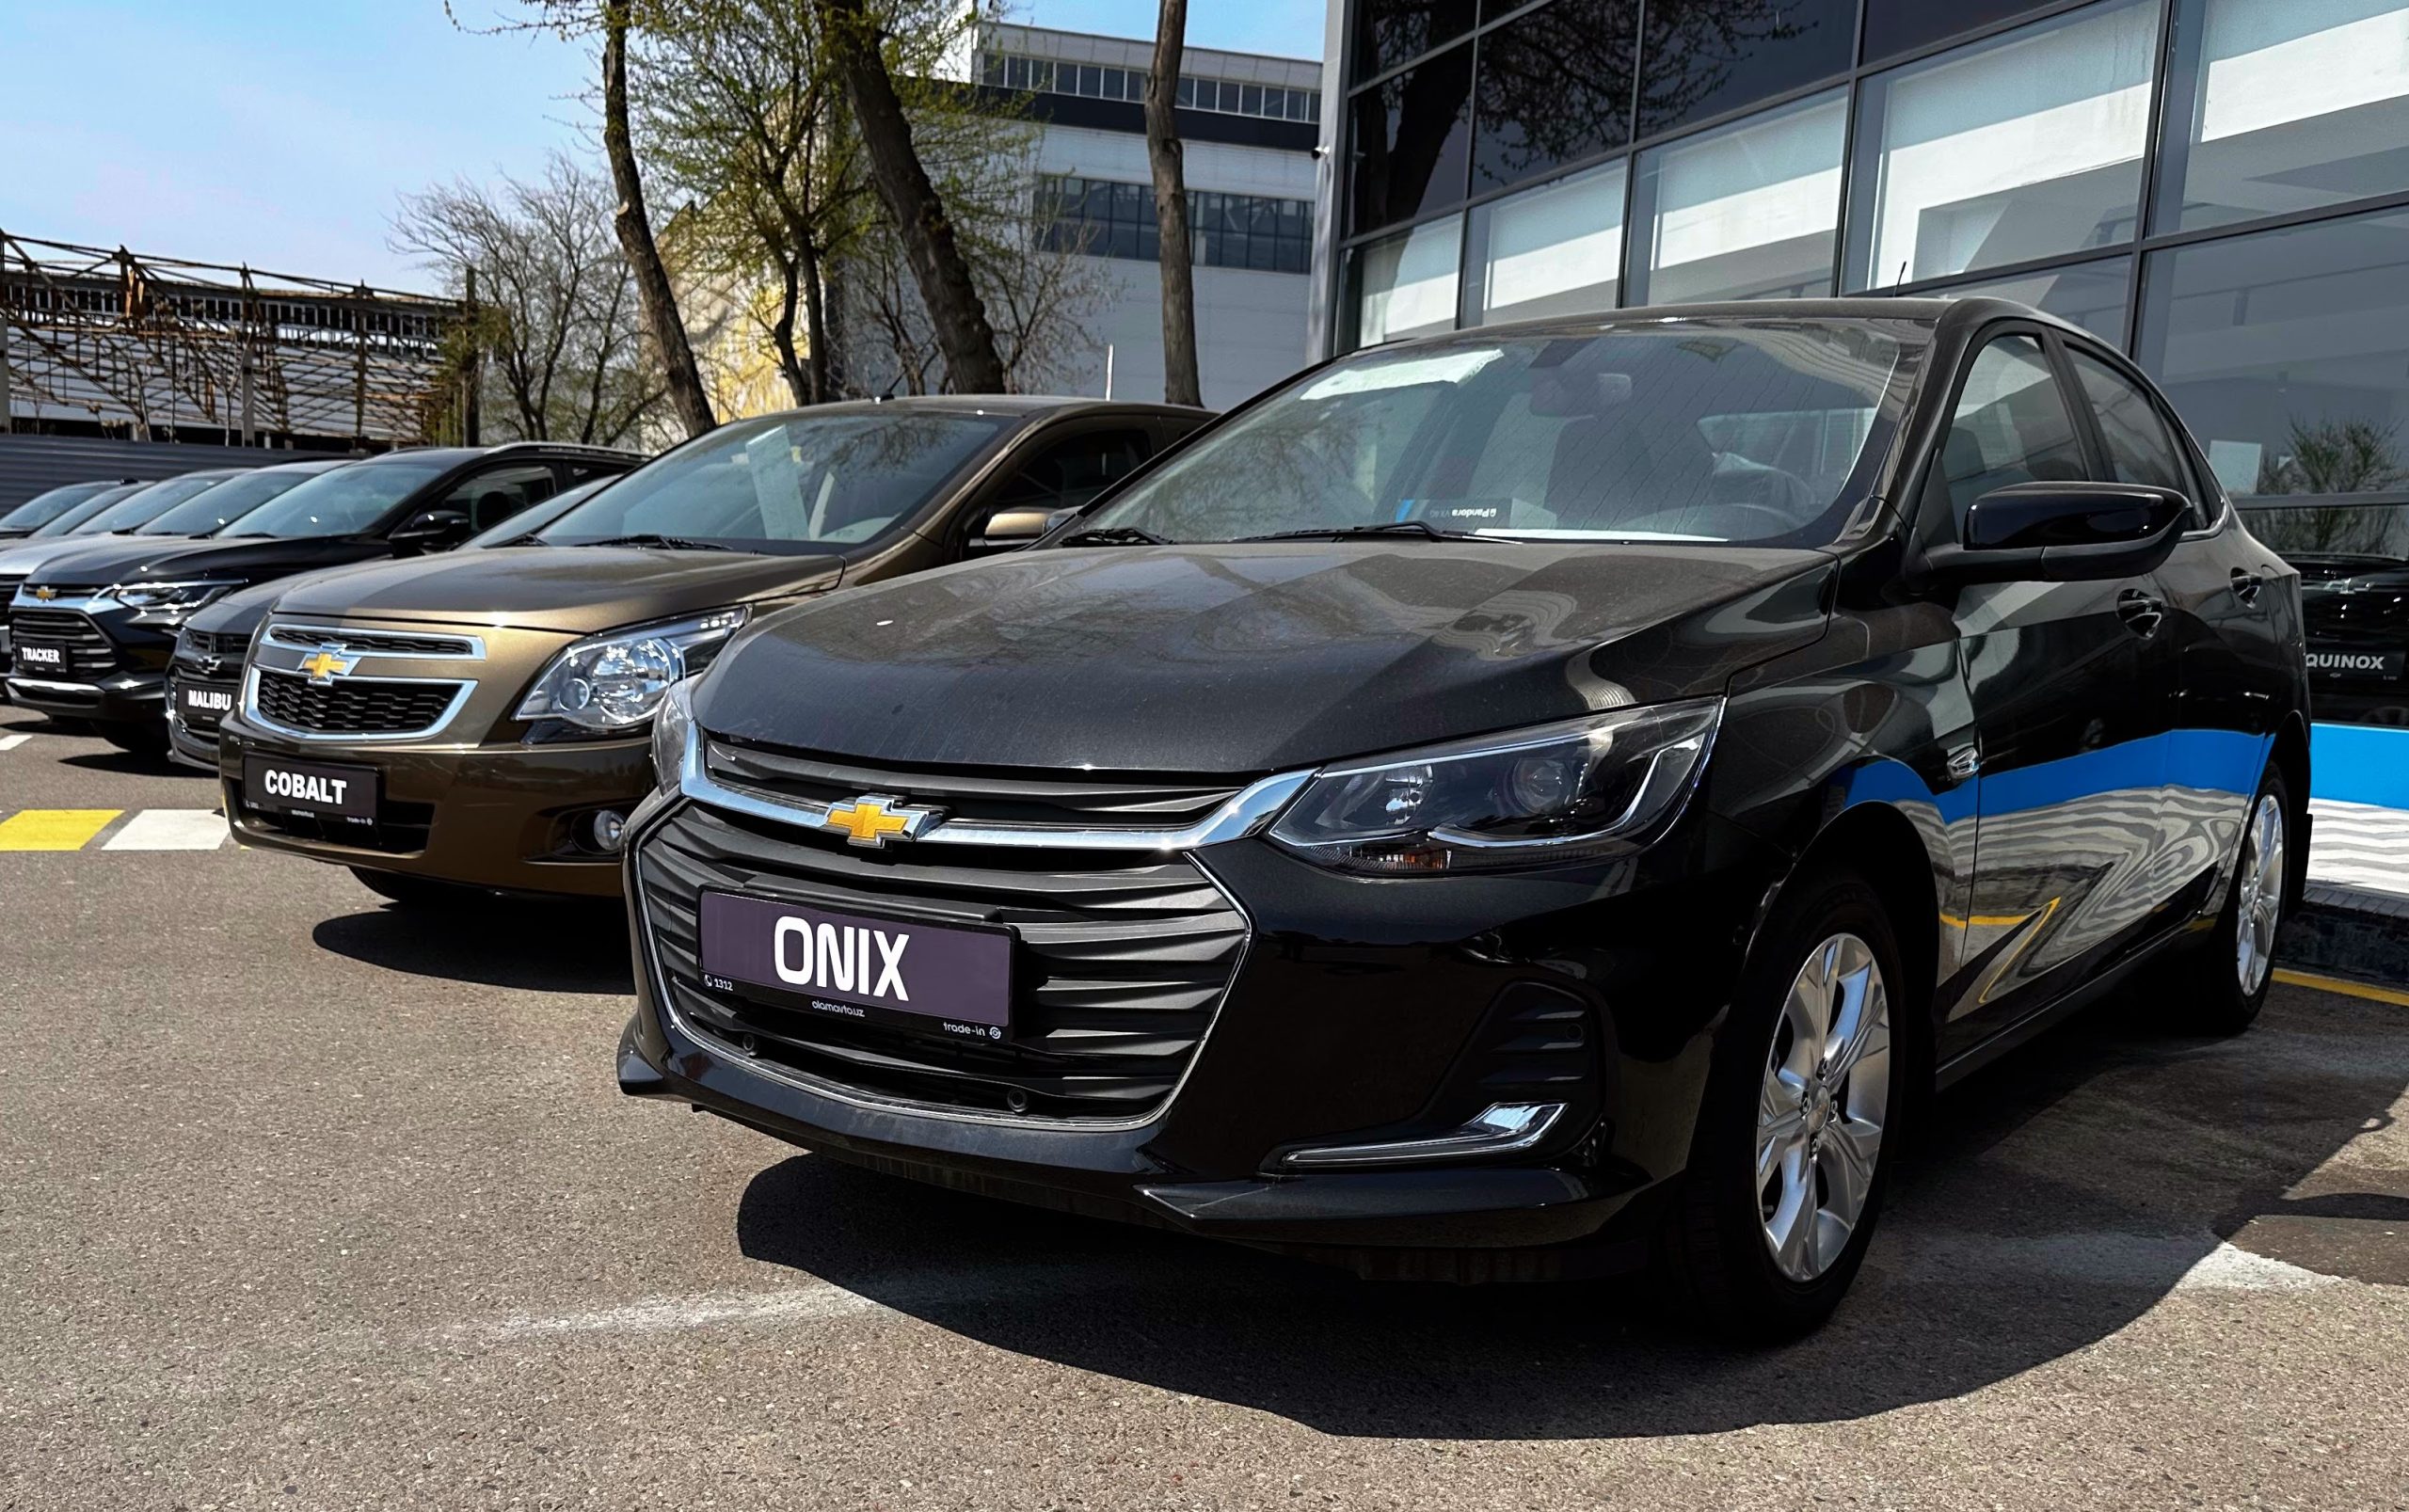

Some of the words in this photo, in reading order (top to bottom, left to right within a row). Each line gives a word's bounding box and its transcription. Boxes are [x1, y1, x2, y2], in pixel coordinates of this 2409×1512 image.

[1451, 508, 1491, 518] Pandora
[21, 646, 60, 663] TRACKER
[2305, 653, 2385, 670] QUINOX
[188, 690, 232, 711] MALIBU
[264, 769, 347, 804] COBALT
[774, 915, 910, 1001] ONIX
[713, 979, 734, 992] 1312
[943, 1022, 986, 1037] trade-in
